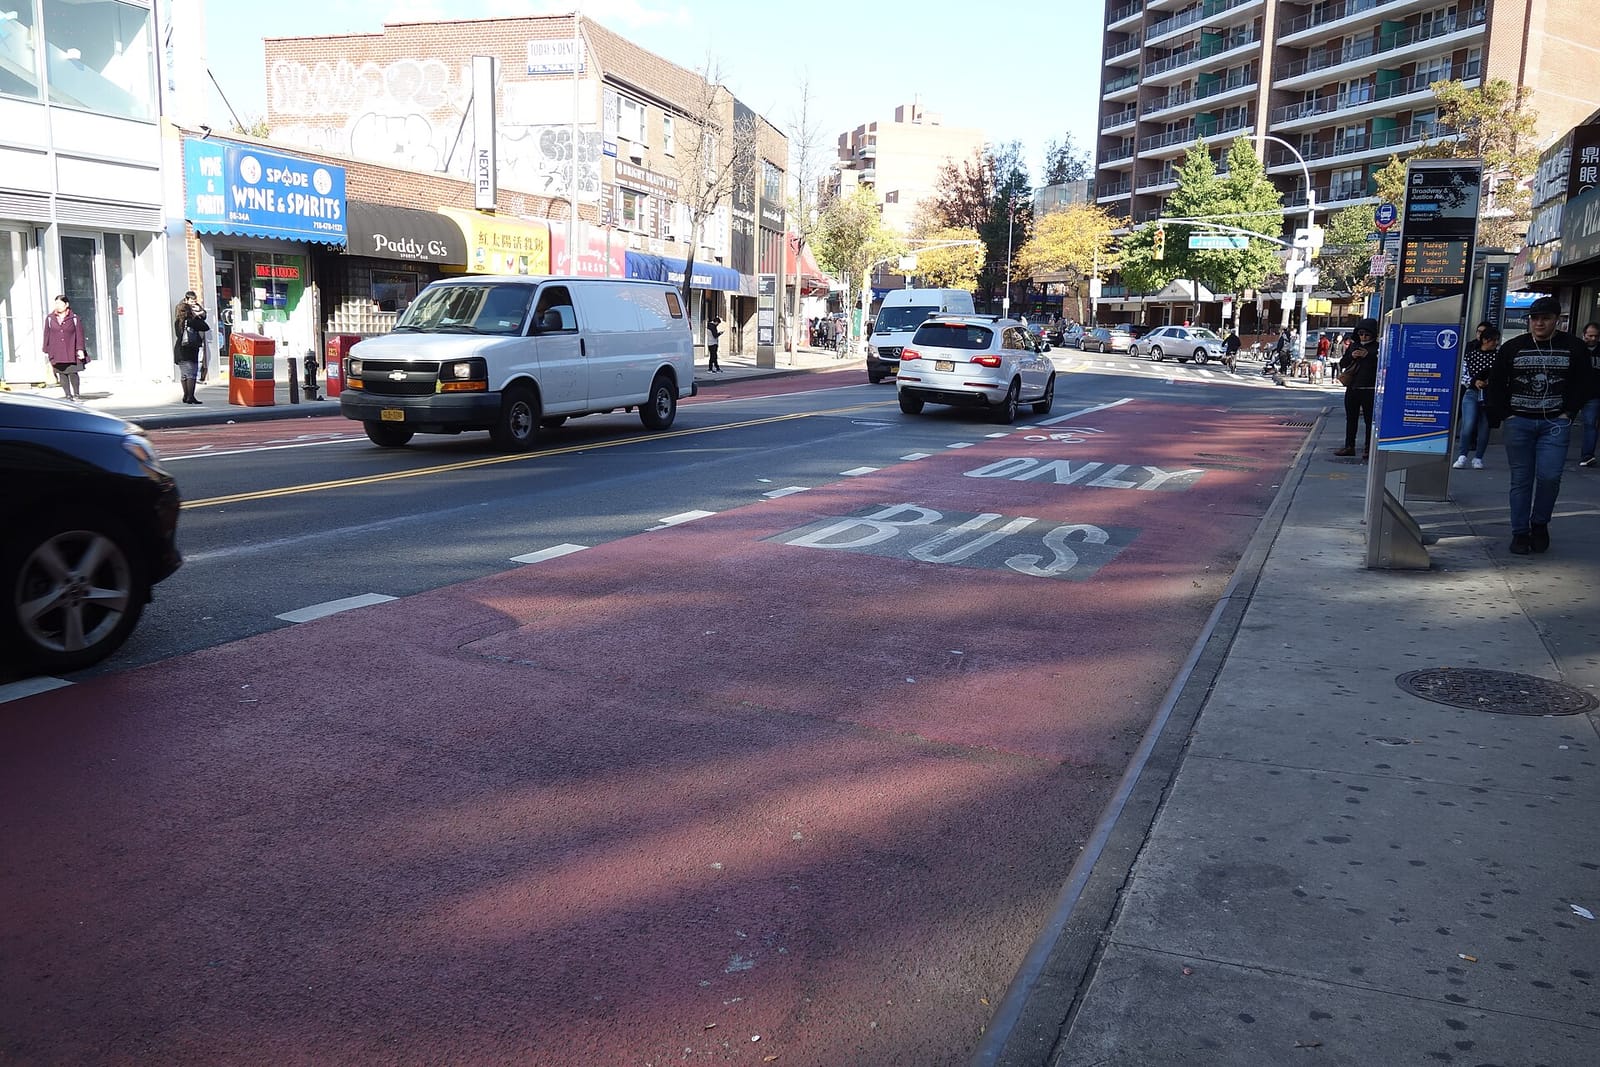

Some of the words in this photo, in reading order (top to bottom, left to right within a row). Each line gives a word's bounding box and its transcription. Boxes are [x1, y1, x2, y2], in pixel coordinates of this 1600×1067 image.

[199, 156, 222, 177] WINE
[479, 149, 489, 193] NEXTEL
[207, 179, 215, 193] &
[196, 194, 225, 215] SPIRITS
[231, 184, 275, 213] WINE
[277, 197, 286, 214] &
[286, 192, 341, 220] SPIRITS
[372, 233, 425, 257] Paddy
[428, 240, 448, 257] G's
[963, 457, 1205, 491] ONLY
[784, 502, 1110, 578] BUS
